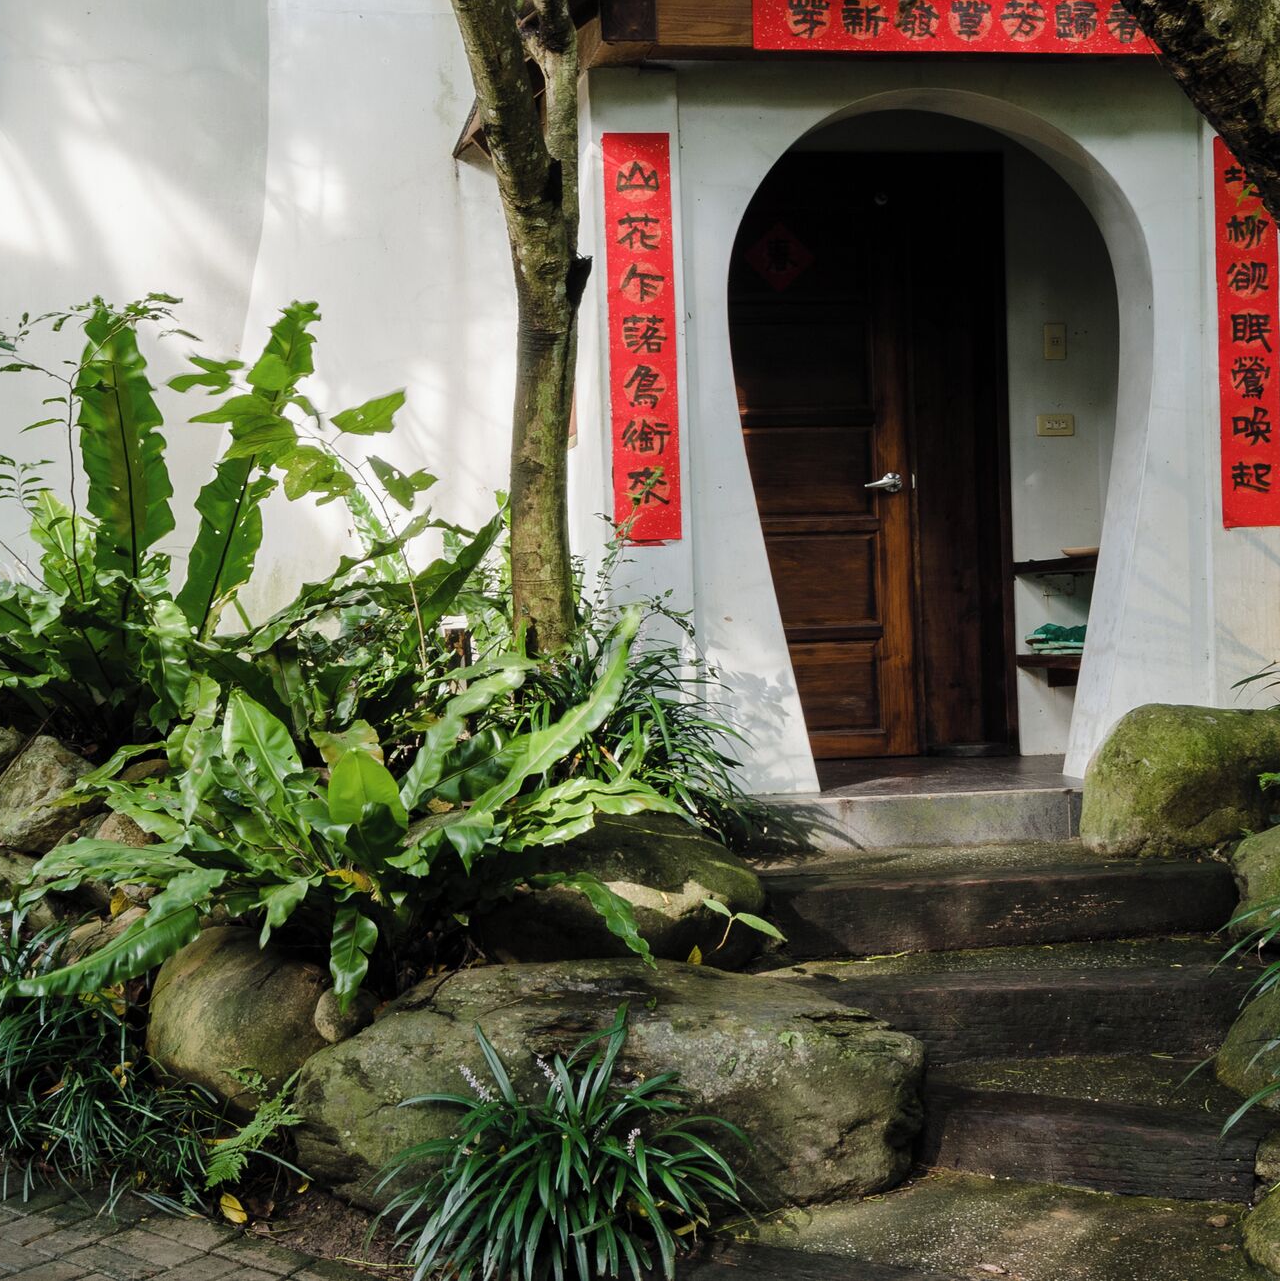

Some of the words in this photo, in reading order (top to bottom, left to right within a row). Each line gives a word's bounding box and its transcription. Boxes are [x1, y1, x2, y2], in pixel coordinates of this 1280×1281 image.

[615, 160, 672, 505] 山花乍落鳥銜來
